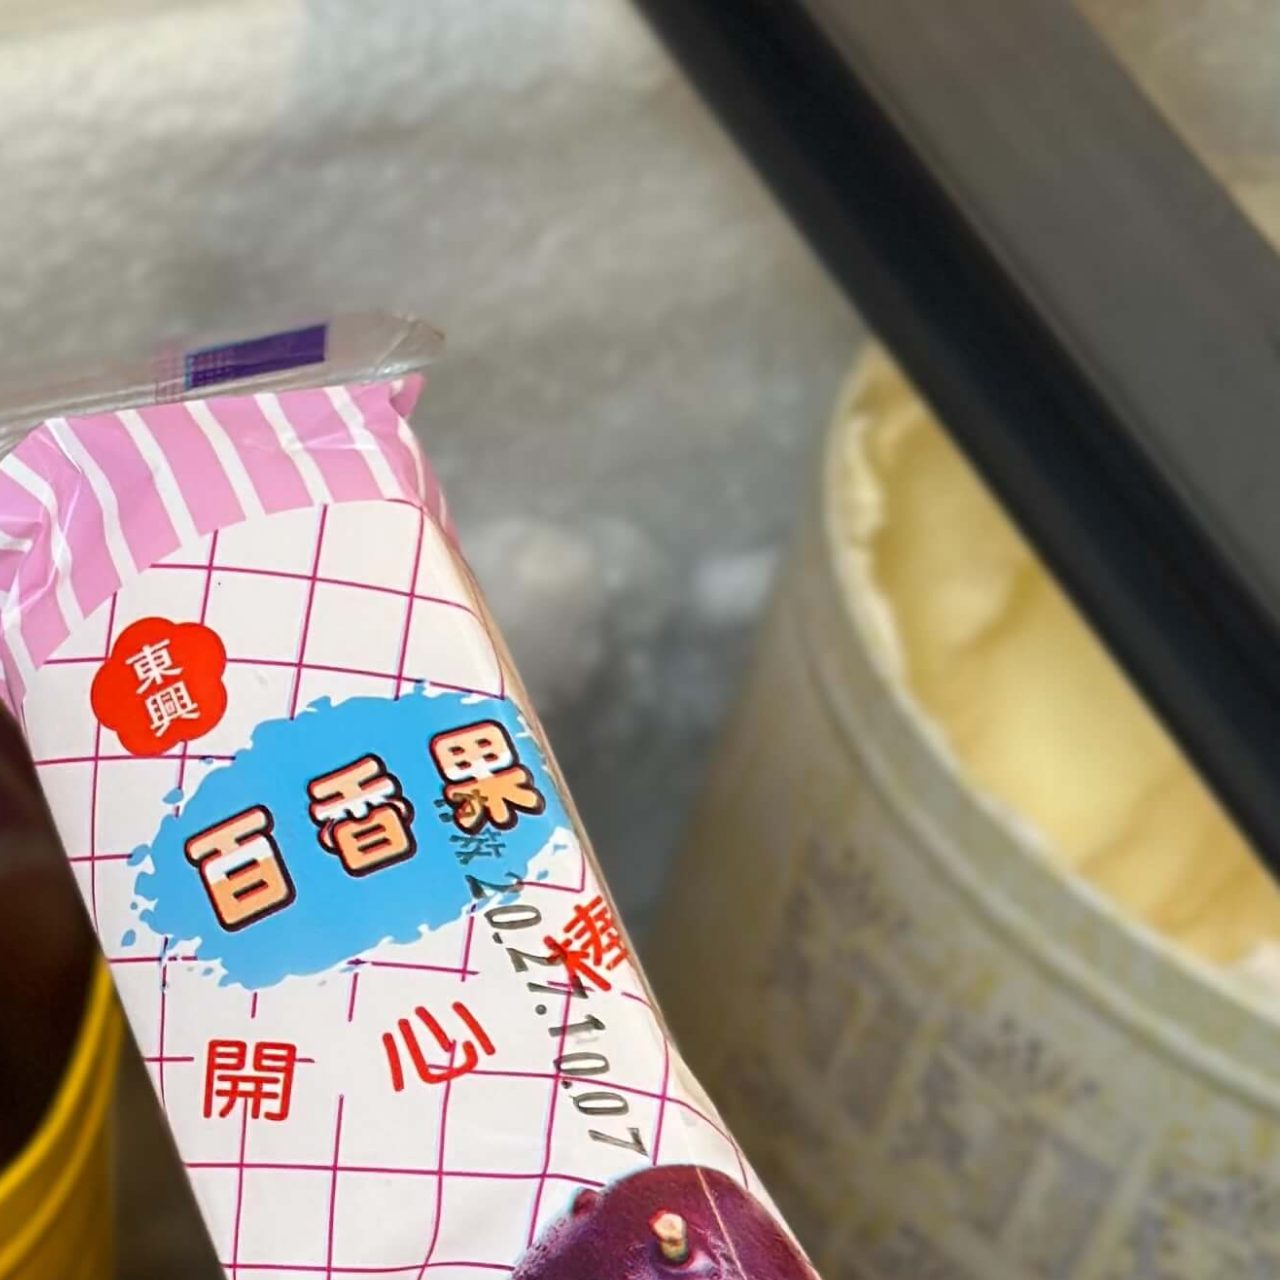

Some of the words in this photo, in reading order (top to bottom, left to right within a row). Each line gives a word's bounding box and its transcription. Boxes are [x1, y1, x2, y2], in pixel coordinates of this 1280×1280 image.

[124, 638, 201, 738] 東興
[183, 719, 544, 933] 百香果
[202, 895, 630, 1121] 開心棒
